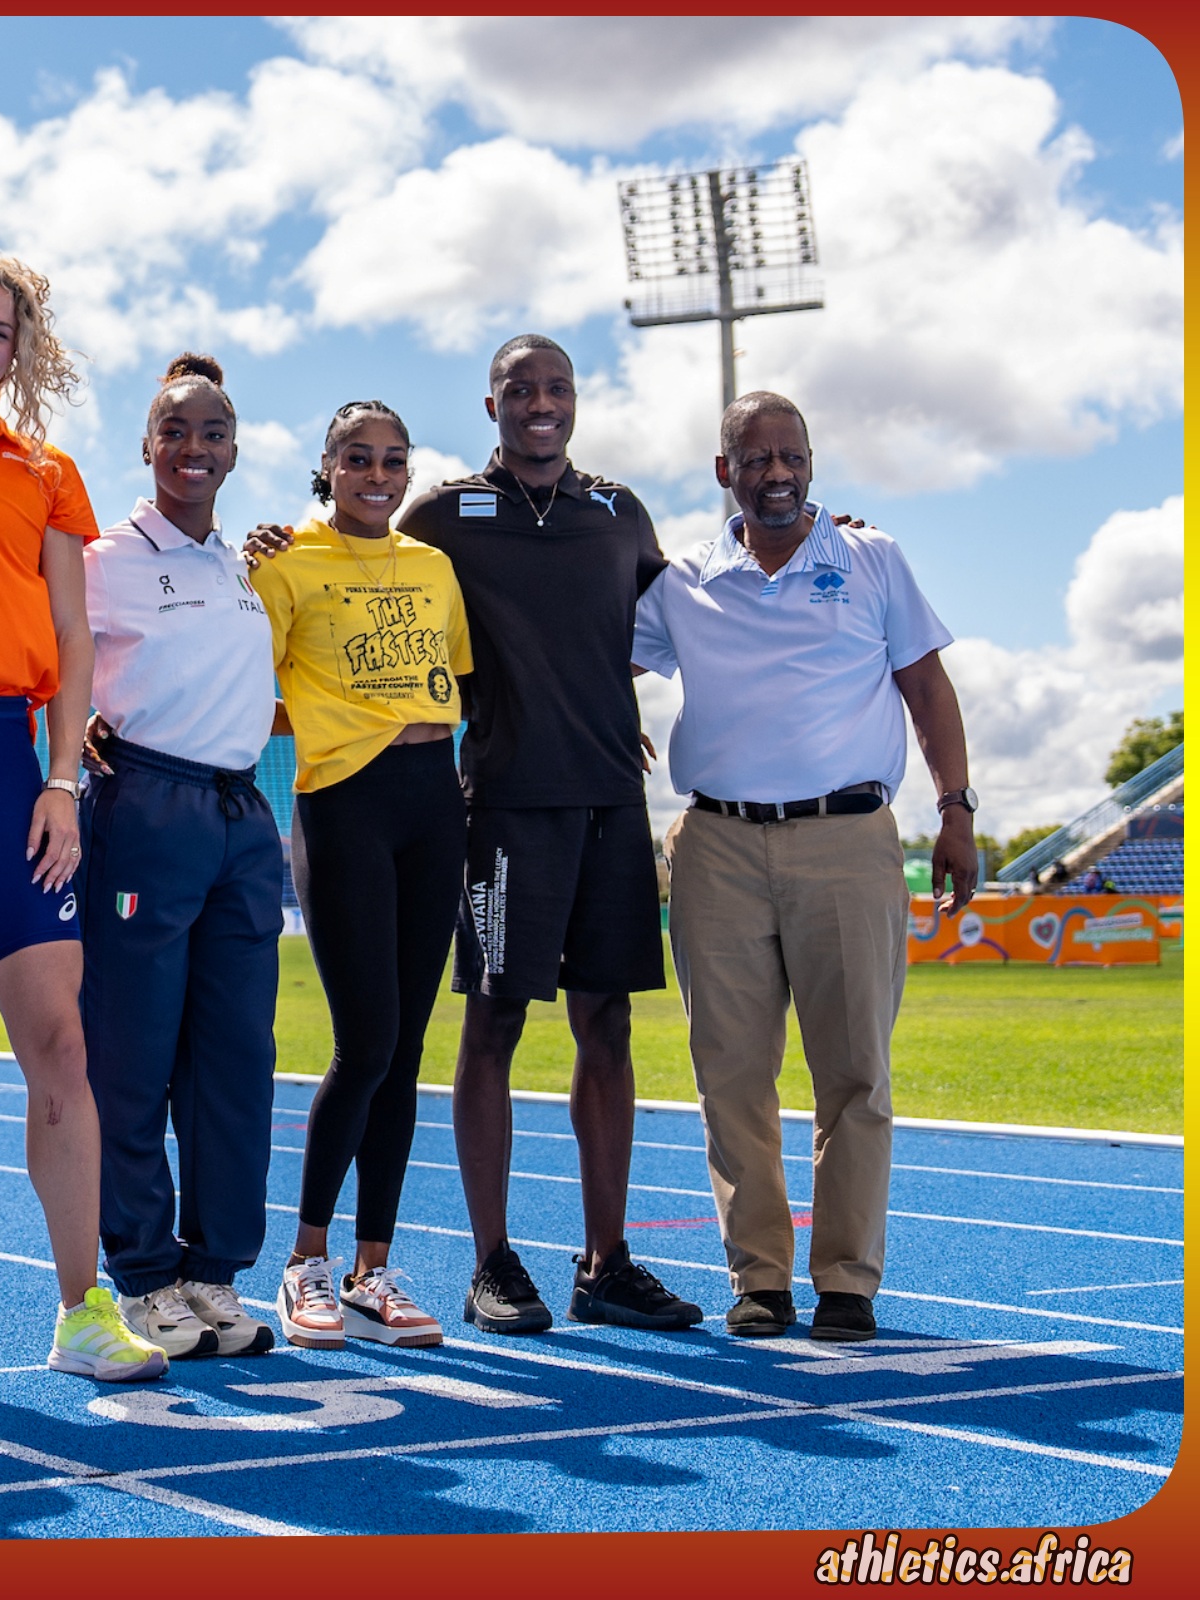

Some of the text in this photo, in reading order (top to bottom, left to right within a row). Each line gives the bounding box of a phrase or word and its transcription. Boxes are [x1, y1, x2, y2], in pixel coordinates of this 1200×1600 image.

[238, 599, 266, 614] ITAL
[366, 595, 417, 630] THE
[343, 628, 448, 676] FASTEST
[351, 682, 424, 690] FASTEST COUNTRY
[434, 674, 448, 693] 8
[472, 881, 487, 951] SWANA
[498, 966, 503, 974] OF
[86, 1374, 563, 1432] 5
